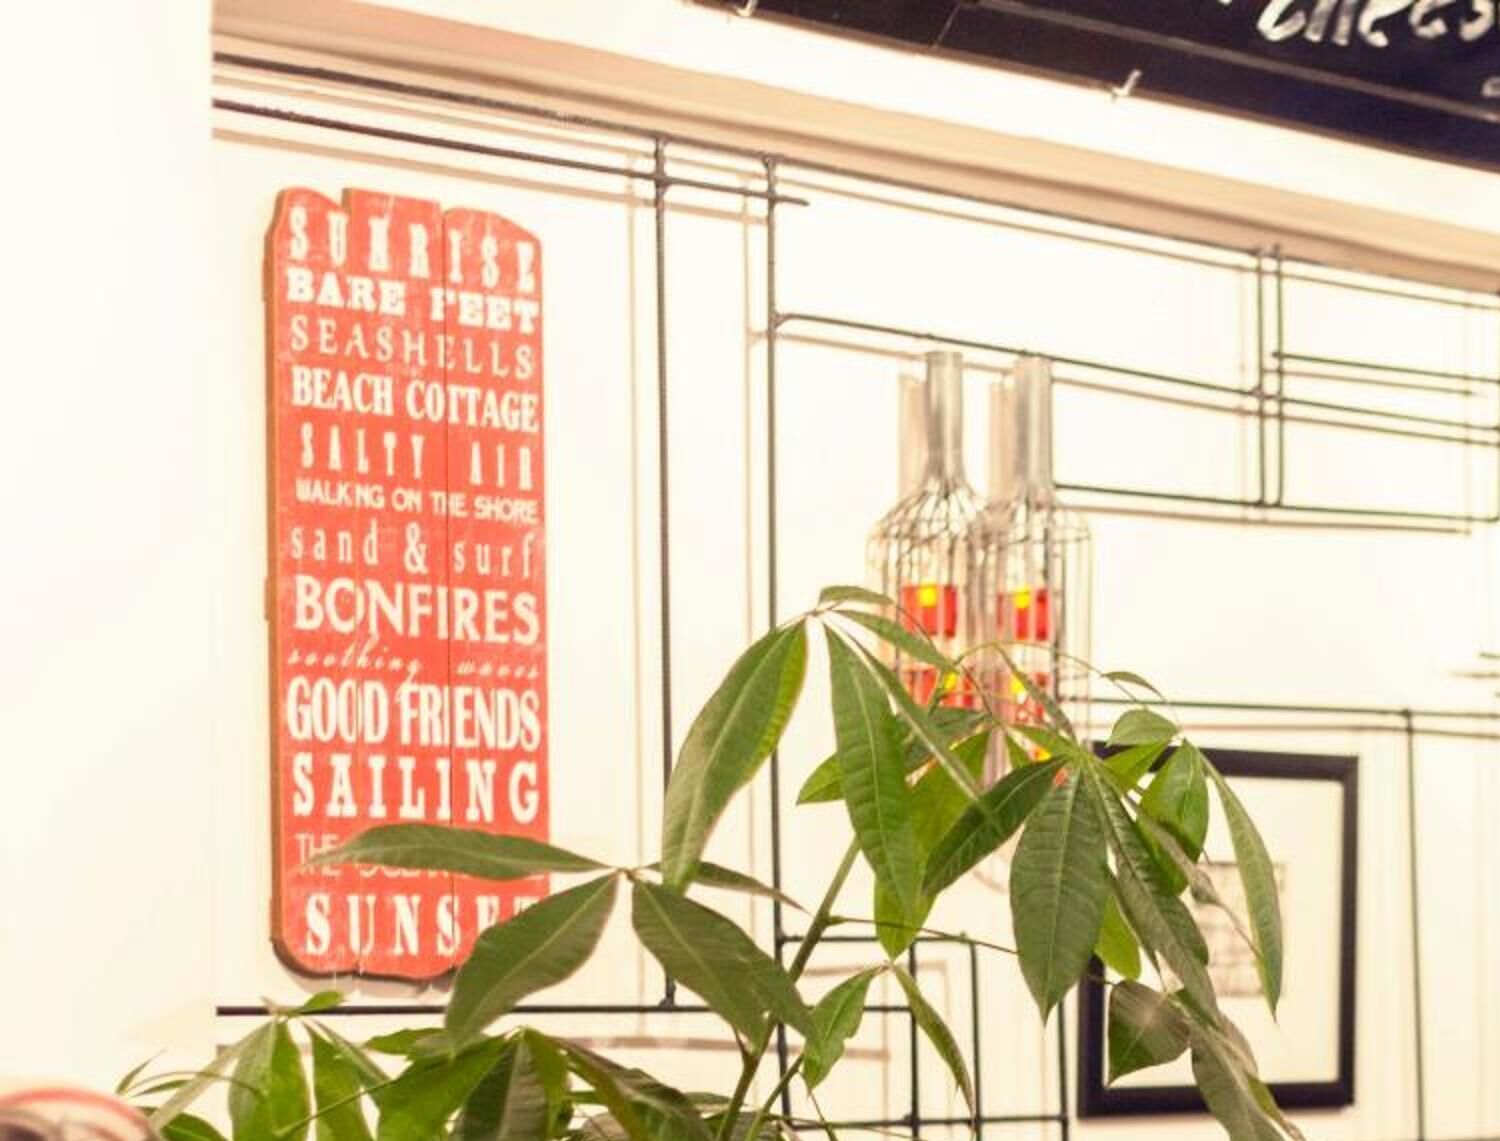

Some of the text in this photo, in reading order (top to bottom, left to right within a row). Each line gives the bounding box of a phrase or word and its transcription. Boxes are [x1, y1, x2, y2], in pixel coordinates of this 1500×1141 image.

[288, 205, 536, 294] SUNRISE
[286, 266, 540, 336] BARE FEET
[290, 313, 535, 381] SEASHELLS
[291, 365, 540, 433] BEACH COTTAGE
[302, 421, 533, 492] SALTY AIR
[295, 477, 539, 525] WALKING ON THE SHORE
[291, 517, 537, 580] sand & surf
[294, 574, 542, 647] BONFIRES
[287, 675, 542, 753] GOOD FRIENDS
[293, 749, 540, 825] SAILING
